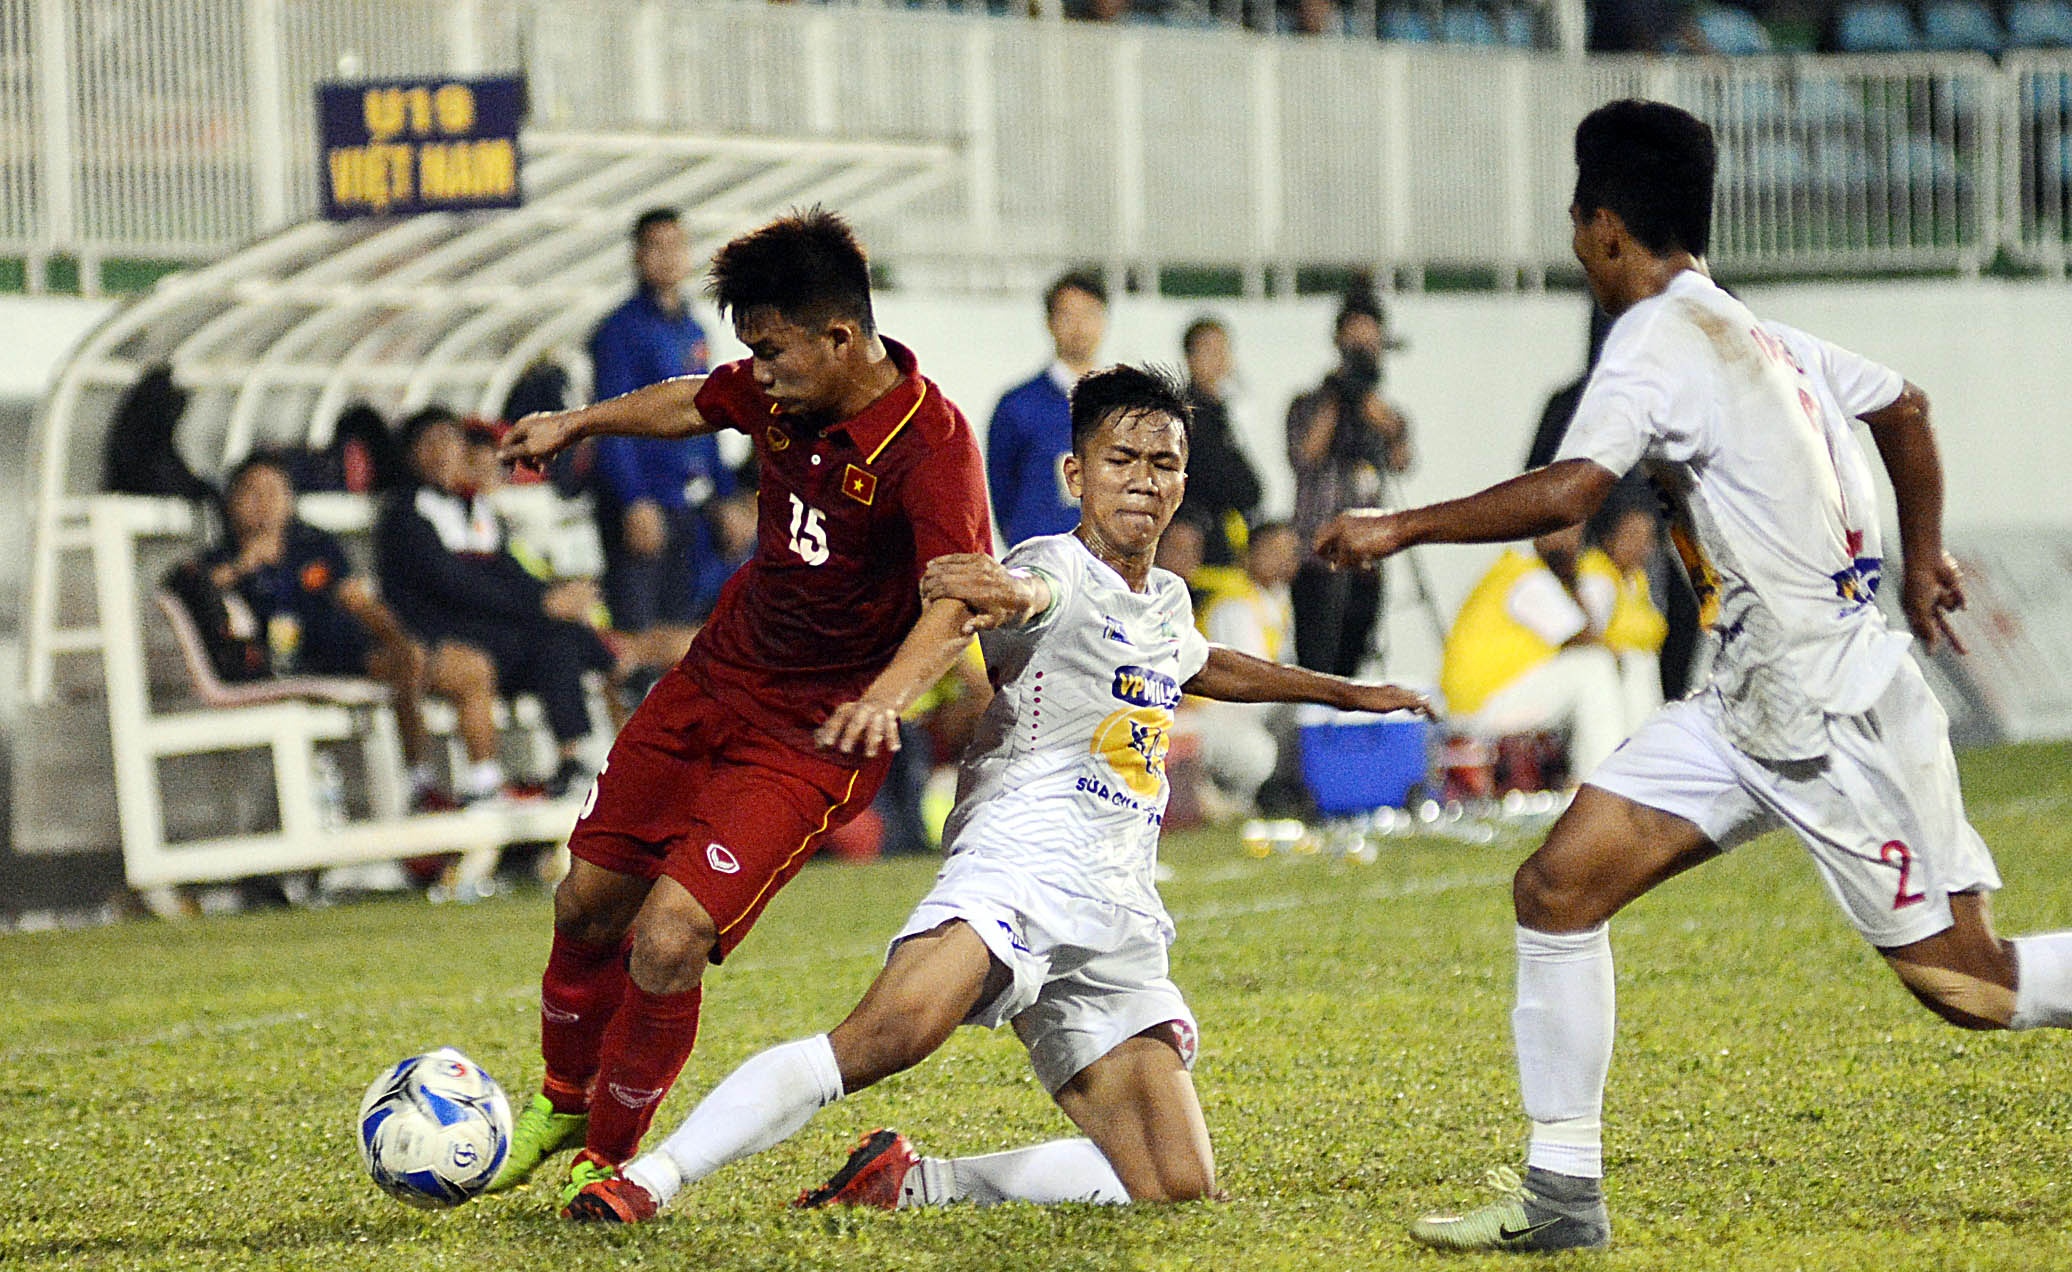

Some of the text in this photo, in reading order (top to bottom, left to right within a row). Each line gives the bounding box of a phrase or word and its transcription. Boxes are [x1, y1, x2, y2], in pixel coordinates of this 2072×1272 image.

[420, 137, 515, 199] NAM
[789, 493, 829, 566] 15
[1881, 840, 1926, 910] 2
